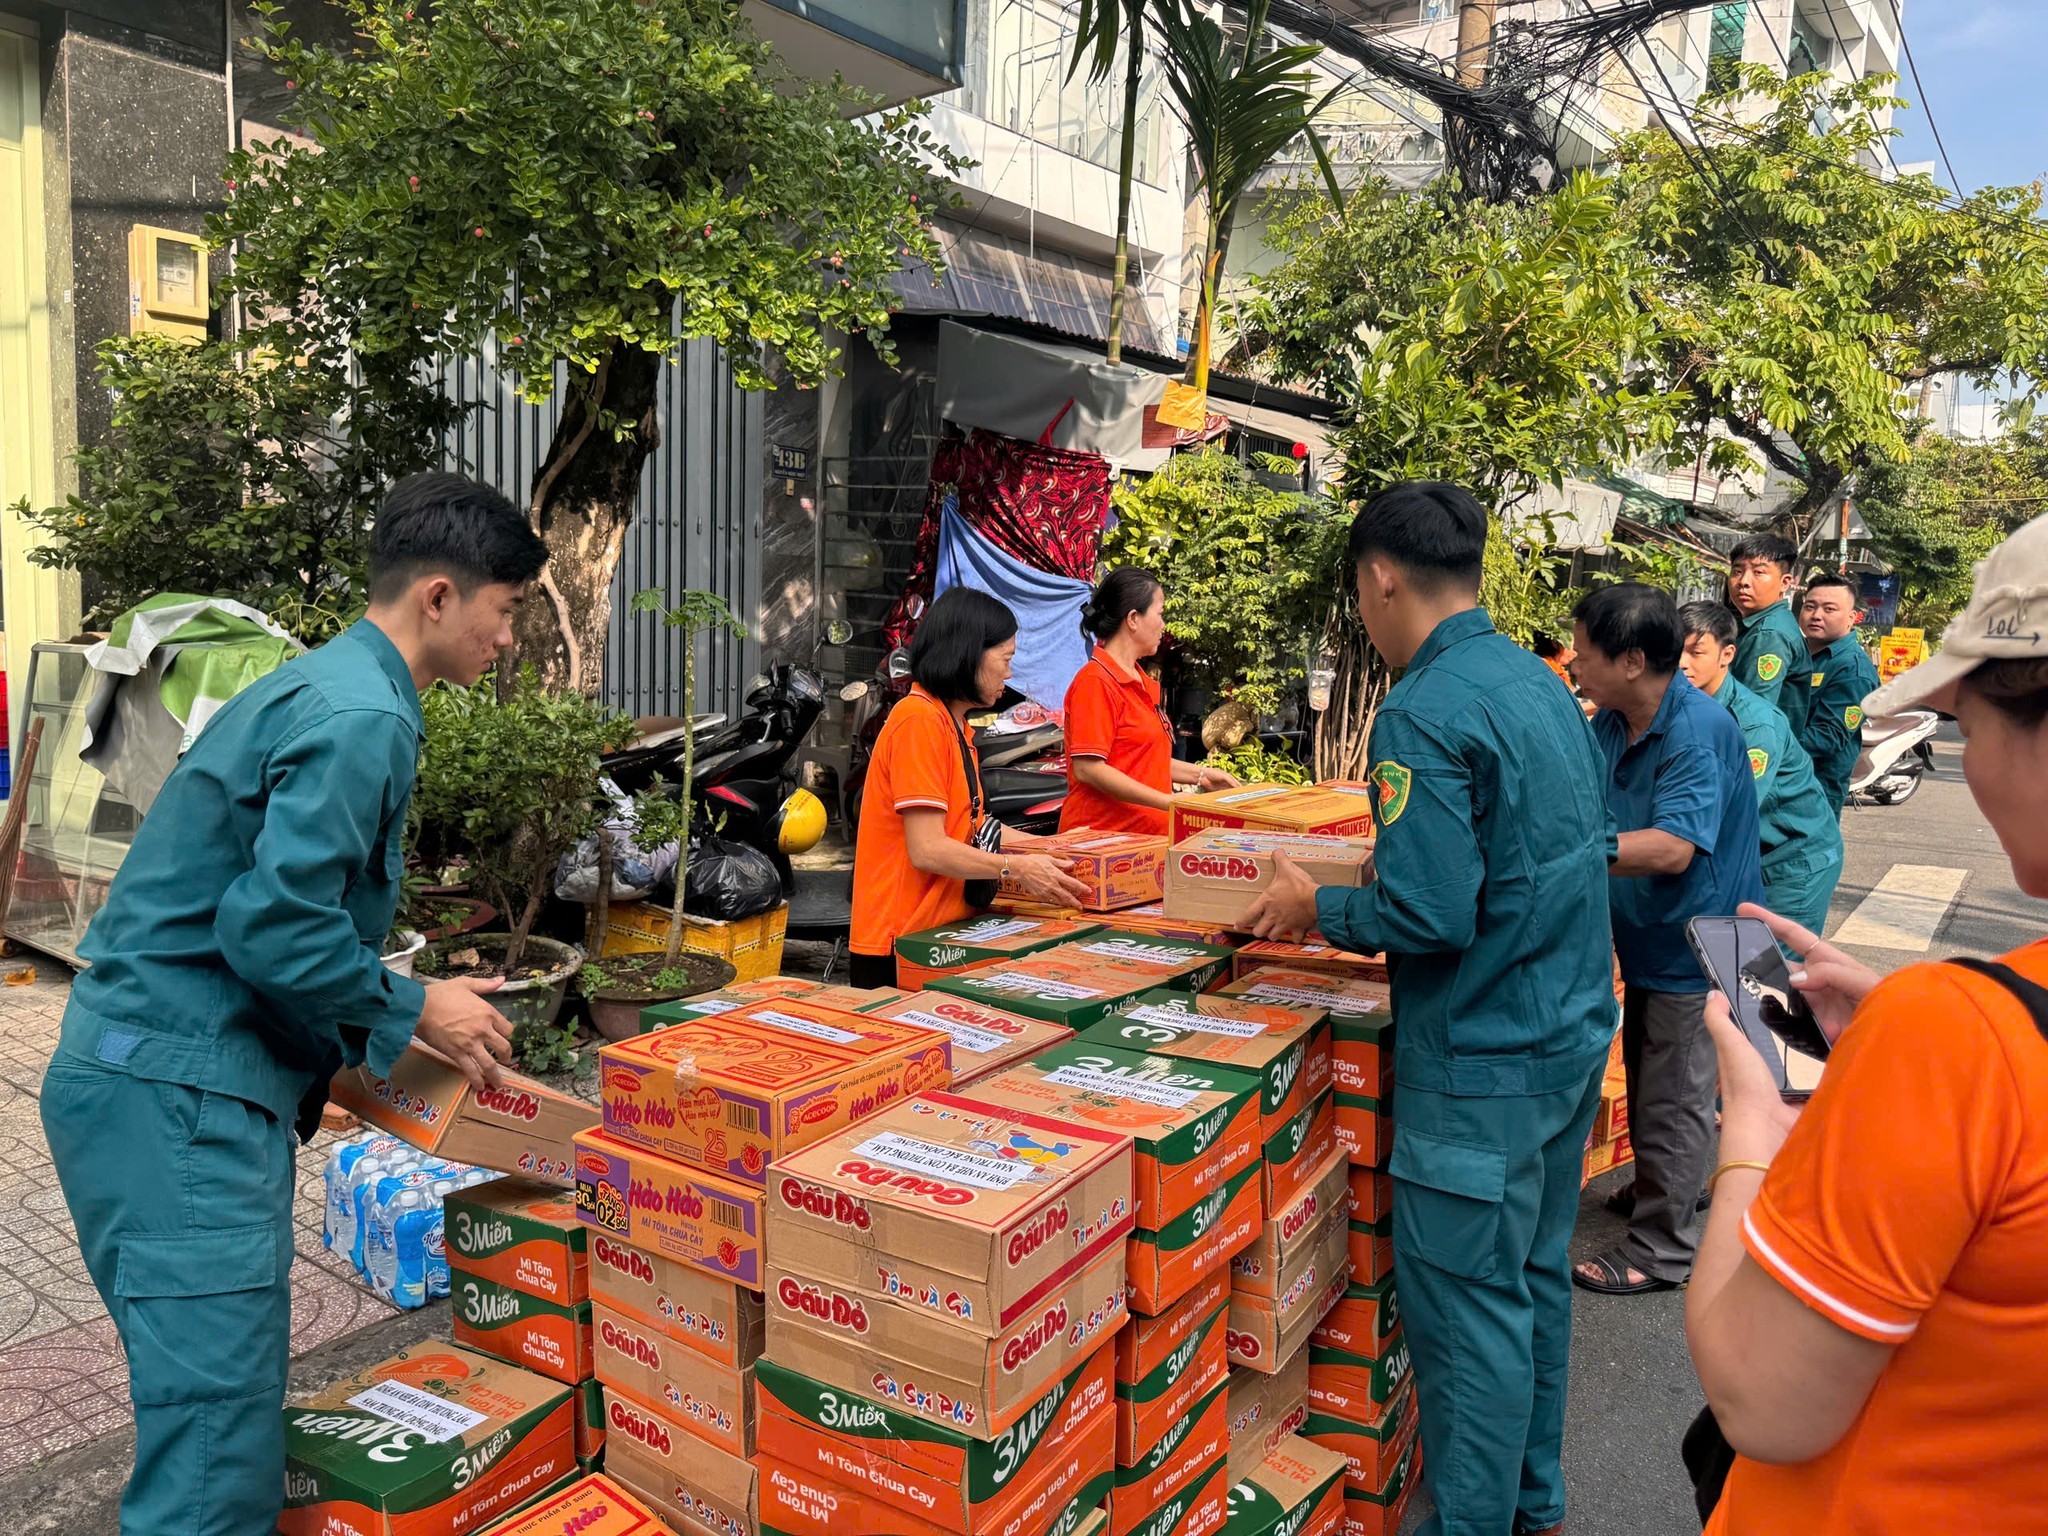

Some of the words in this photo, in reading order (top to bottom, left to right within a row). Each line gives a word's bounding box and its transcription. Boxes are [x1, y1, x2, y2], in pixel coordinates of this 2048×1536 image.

[1340, 1072, 1365, 1088] Cay
[613, 1094, 642, 1124] Hảo
[645, 1097, 675, 1128] Hảo
[518, 1152, 534, 1170] Gà
[1336, 1138, 1361, 1154] Cay
[1194, 1173, 1204, 1187] Mì
[1204, 1162, 1219, 1178] Tôm
[1220, 1150, 1237, 1168] Chua
[1238, 1141, 1250, 1158] Cay
[628, 1178, 663, 1212] Hảo
[666, 1184, 703, 1219] Hảo
[669, 1226, 688, 1241] CHUA
[690, 1235, 703, 1246] CAY
[1072, 1226, 1093, 1249] Tôm
[1097, 1211, 1108, 1231] và
[1111, 1198, 1125, 1217] Gà
[1193, 1257, 1203, 1271] Mì
[1203, 1244, 1219, 1260] Tôm
[1220, 1231, 1237, 1249] Chua
[1238, 1221, 1250, 1238] Cay
[516, 1269, 539, 1286] Chua
[540, 1277, 557, 1294] Cay
[520, 1257, 532, 1269] Mì
[533, 1260, 553, 1277] Tôm
[878, 1268, 913, 1297] Tôm
[919, 1285, 939, 1308] và
[945, 1292, 972, 1319] Gà
[657, 1296, 674, 1318] Gà
[677, 1305, 697, 1330] Sợi
[699, 1314, 725, 1341] Phở
[1170, 1323, 1178, 1337] Mì
[1209, 1284, 1221, 1299] Cay
[527, 1331, 539, 1344] Mì
[540, 1335, 560, 1352] Tôm
[1069, 1323, 1084, 1345] Gà
[1330, 1328, 1351, 1342] Cay
[523, 1344, 546, 1361] Chua
[547, 1353, 565, 1368] Cay
[872, 1372, 899, 1397] Gà
[904, 1383, 933, 1412] Sợi
[937, 1393, 975, 1426] Phở
[1071, 1397, 1082, 1413] Mì
[1083, 1377, 1103, 1397] Tôm
[1166, 1406, 1175, 1419] Mì
[1207, 1361, 1218, 1375] Cay
[1326, 1392, 1349, 1407] Cay
[664, 1383, 681, 1406] Gà
[684, 1394, 703, 1420] Sợi
[707, 1403, 732, 1431] Phở
[1065, 1407, 1089, 1433] Chua
[1090, 1388, 1106, 1408] Cay
[771, 1471, 798, 1492] Cay
[818, 1448, 834, 1466] Mì
[836, 1455, 866, 1478] Tôm
[869, 1470, 906, 1494] Chua
[909, 1486, 935, 1508] Cay
[1153, 1485, 1163, 1498] Mì
[1164, 1471, 1182, 1488] Tôm
[1183, 1455, 1203, 1473] Chua
[1204, 1440, 1218, 1456] Cay
[453, 1511, 468, 1528] Mì
[471, 1496, 498, 1516] Tôm
[501, 1475, 531, 1499] Chua
[533, 1459, 555, 1480] Cay
[573, 1489, 593, 1503] SUNG
[778, 1492, 808, 1514] Tôm
[801, 1481, 838, 1510] Chua
[1200, 1499, 1218, 1516] Tôm
[675, 1487, 692, 1509] Gà
[696, 1499, 716, 1524] Sợi
[718, 1510, 745, 1536] Phở
[812, 1507, 828, 1523] Mì
